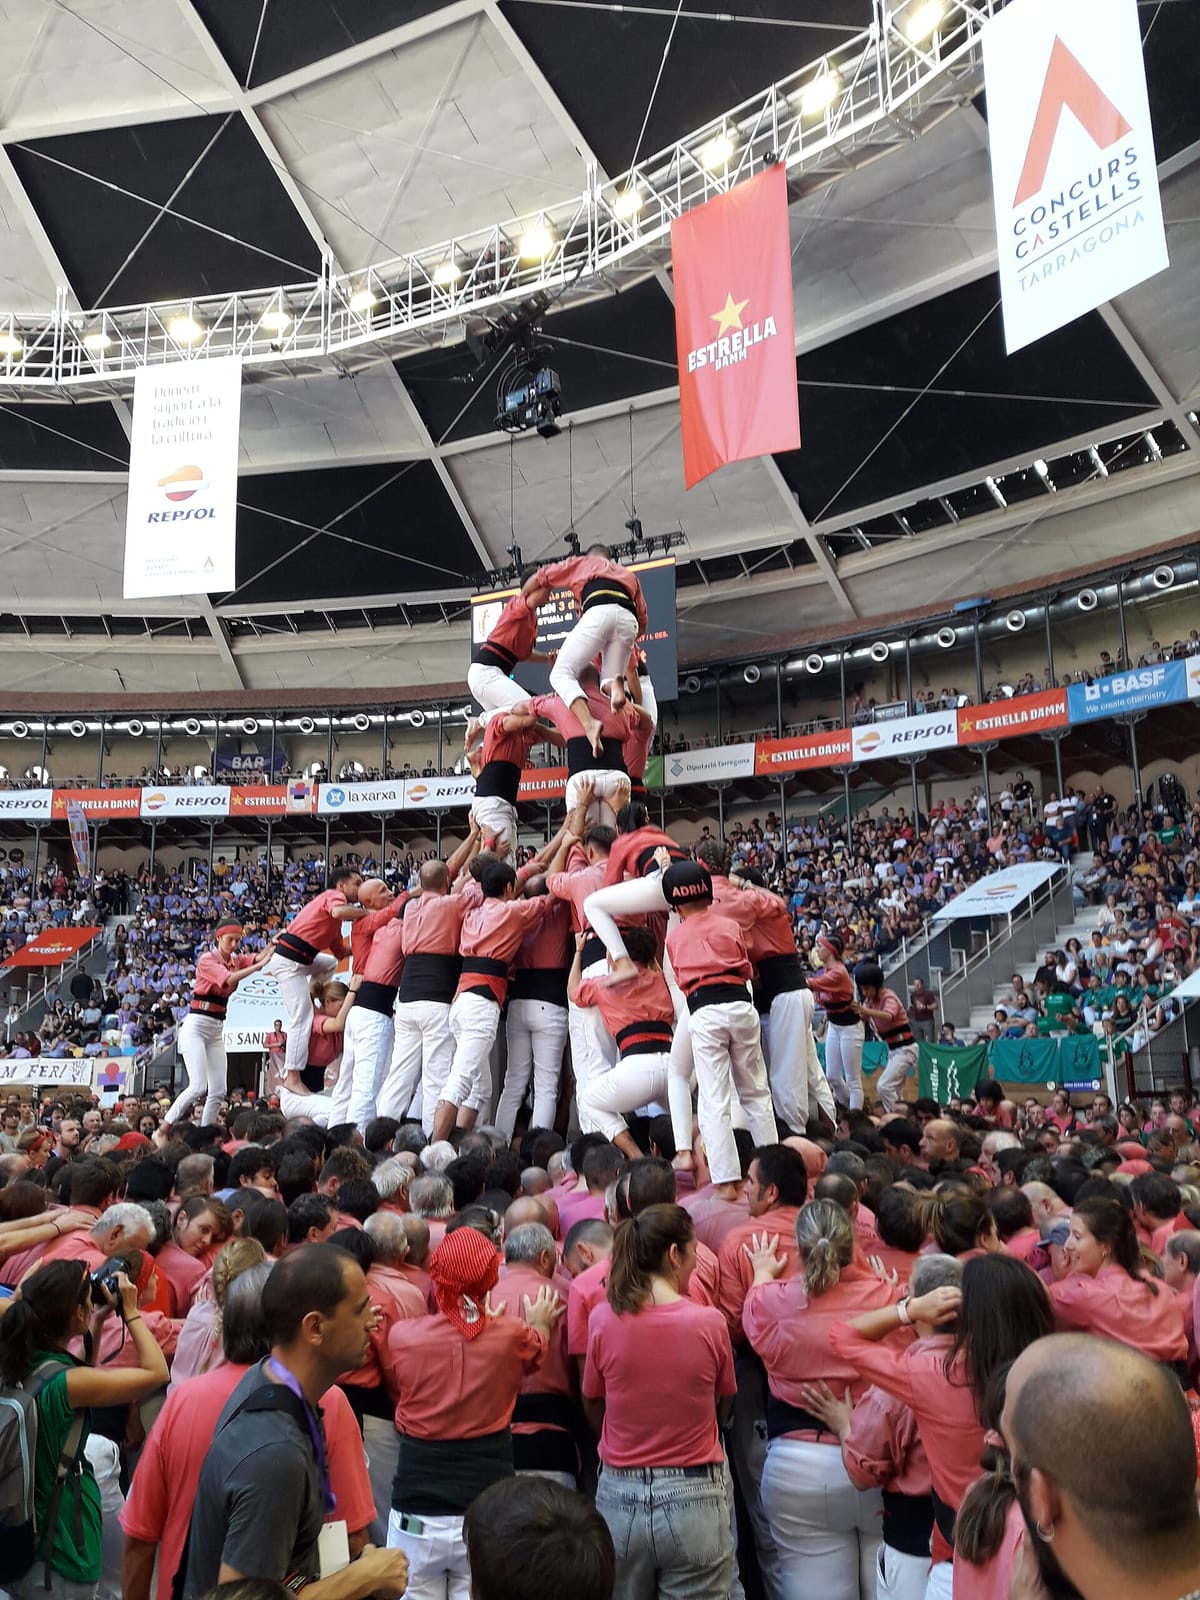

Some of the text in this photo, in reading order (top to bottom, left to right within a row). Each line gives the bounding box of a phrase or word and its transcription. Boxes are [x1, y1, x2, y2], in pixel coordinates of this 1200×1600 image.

[1013, 147, 1138, 236] CONCURS
[1015, 171, 1141, 259] CASTELLS
[1018, 210, 1145, 292] TARRAGONA
[687, 315, 777, 373] ESTRELLA
[715, 348, 747, 371] DAMM
[147, 507, 216, 523] REPSOL
[1112, 668, 1165, 695] BASF
[1086, 704, 1099, 713] We
[1126, 690, 1168, 705] chemistry
[975, 702, 1065, 731] ESTRELLA DAMM
[891, 723, 954, 743] REPSOL
[231, 756, 265, 770] BAR
[771, 741, 850, 763] ESTRELLA DAMM
[519, 780, 546, 791] RELLA
[110, 799, 138, 809] DAMM
[175, 797, 228, 807] REPSOL
[237, 1032, 268, 1046] SANI
